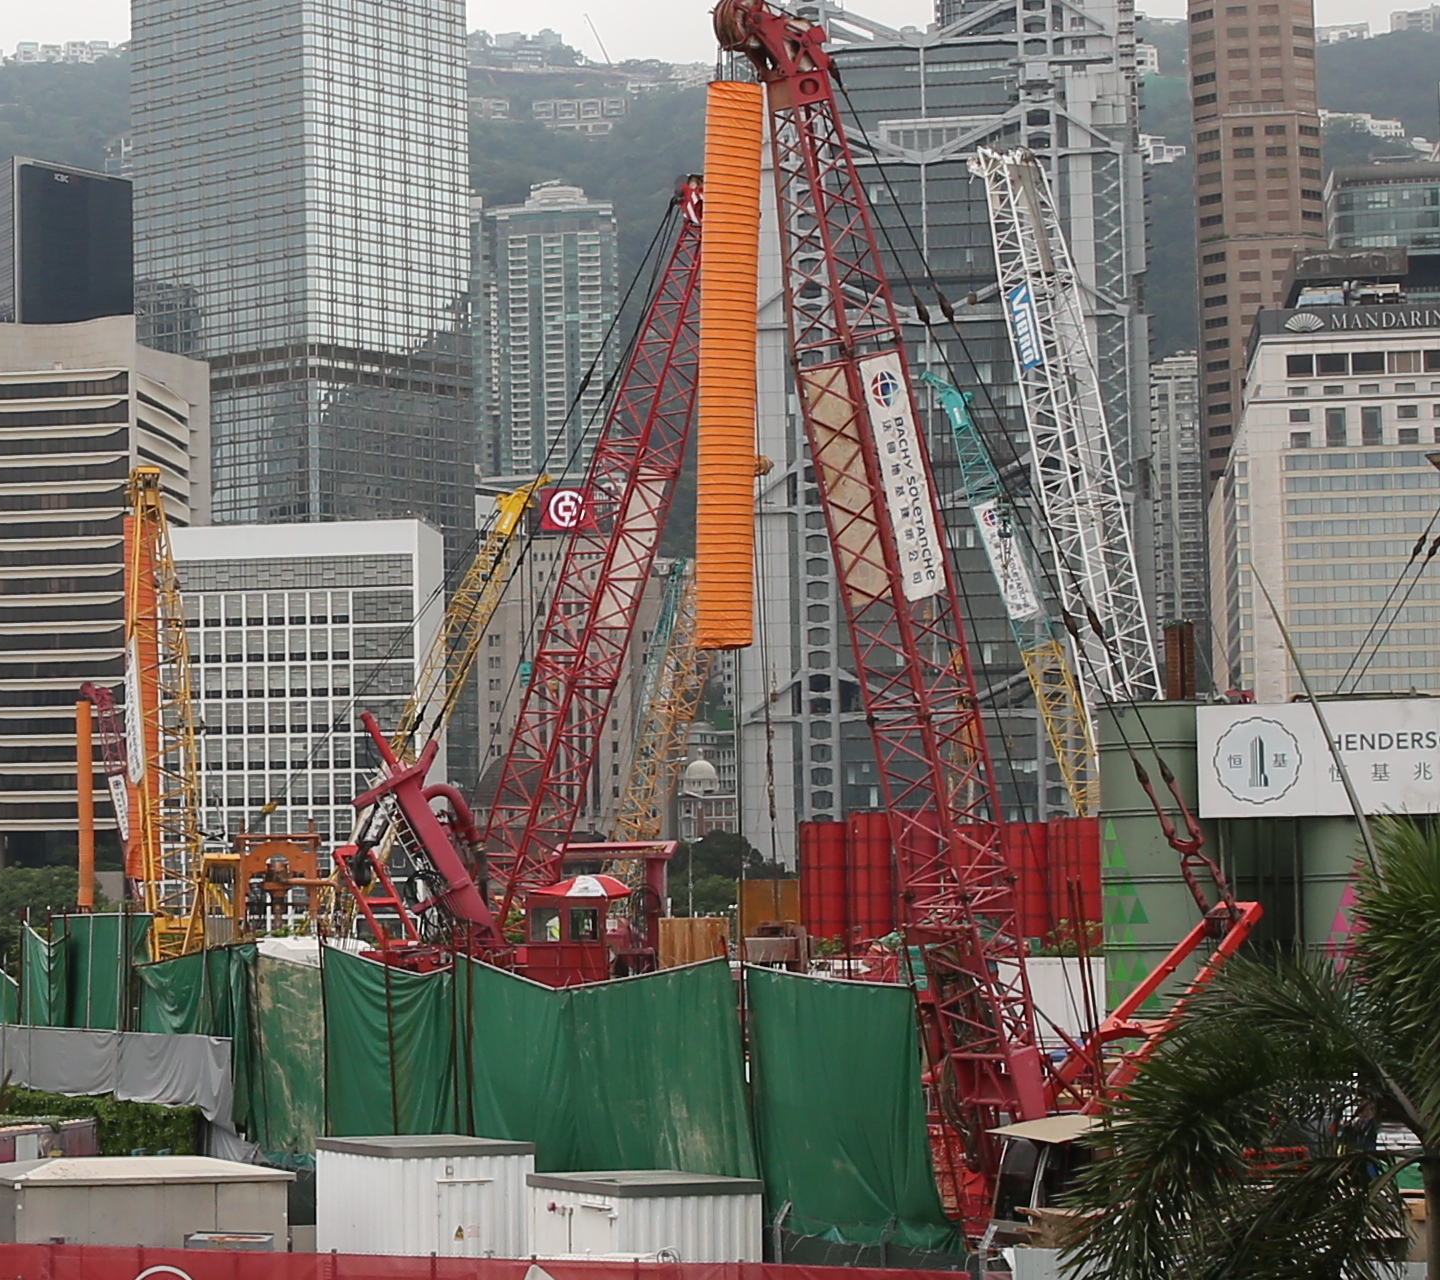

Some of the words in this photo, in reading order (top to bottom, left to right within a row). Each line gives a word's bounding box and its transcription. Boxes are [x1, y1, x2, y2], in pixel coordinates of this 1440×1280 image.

[893, 416, 914, 470] BACHY
[1227, 754, 1243, 769] 恒
[1273, 753, 1287, 768] 基
